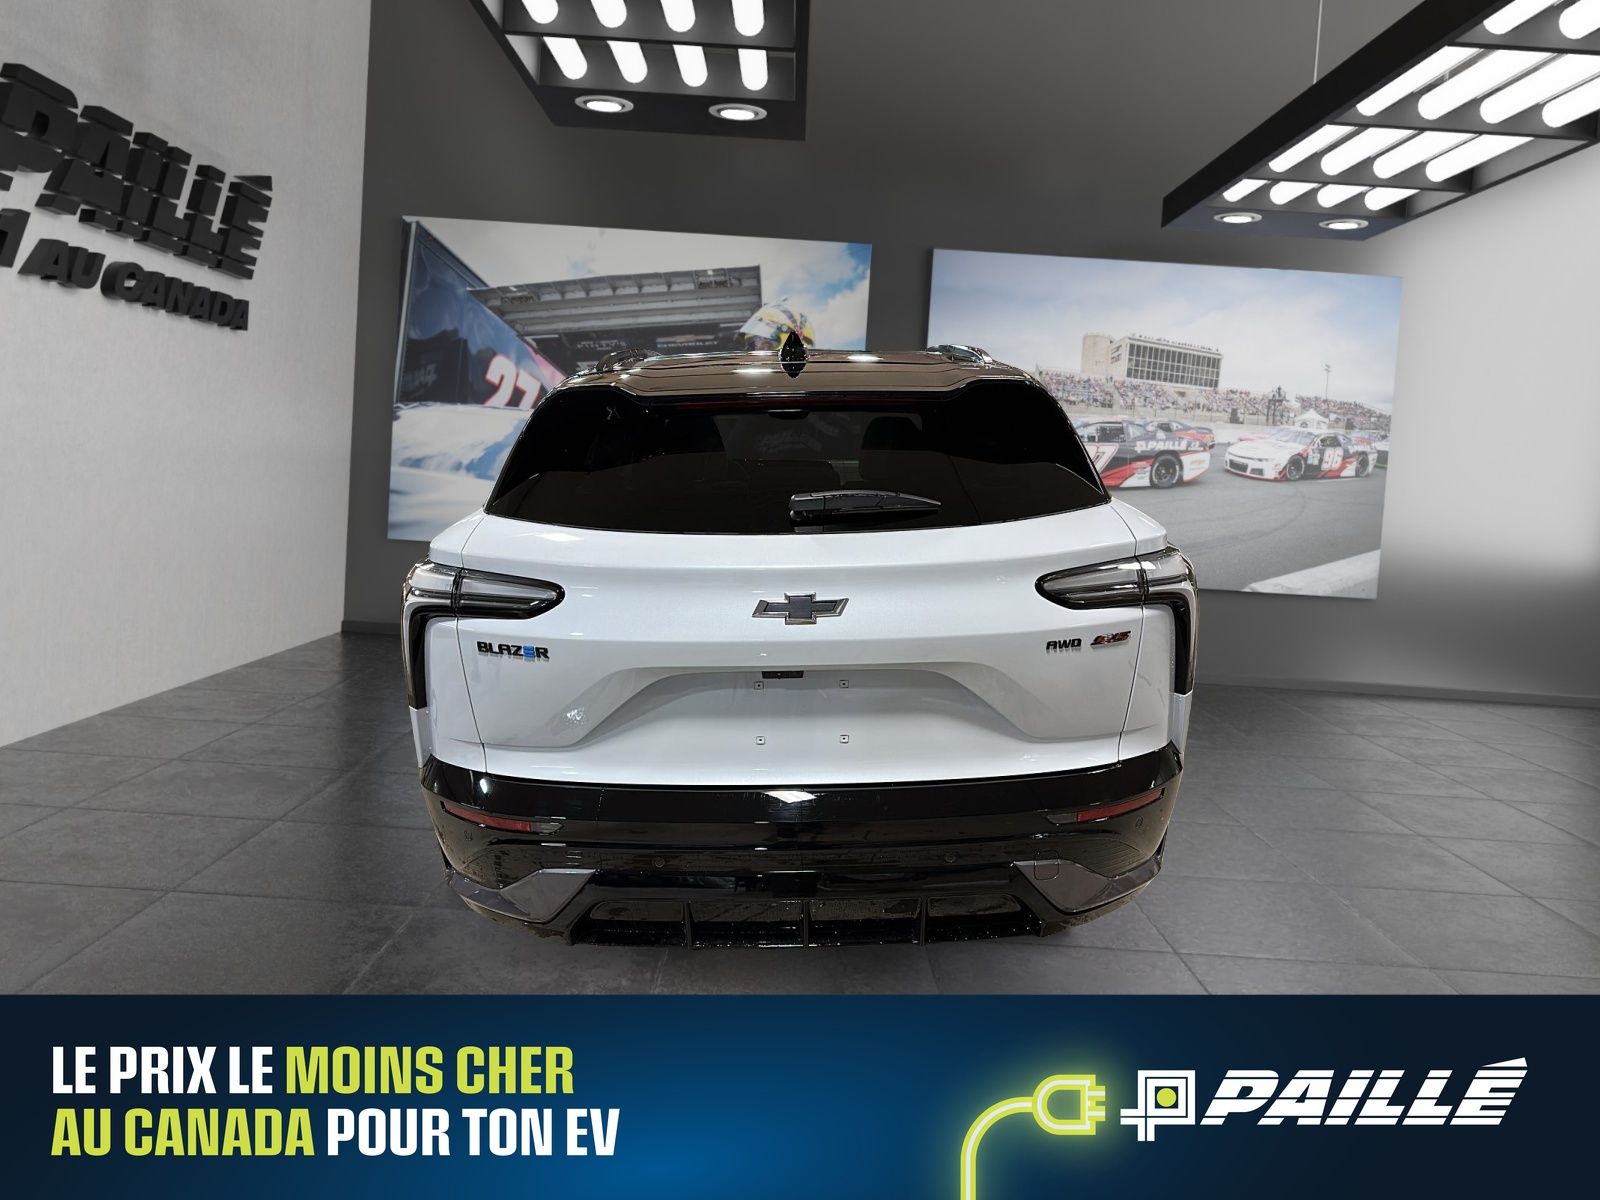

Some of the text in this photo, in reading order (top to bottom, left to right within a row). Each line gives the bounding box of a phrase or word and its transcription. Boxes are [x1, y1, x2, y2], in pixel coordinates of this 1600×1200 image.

[18, 238, 106, 289] AU
[100, 261, 249, 331] CANADA
[481, 353, 542, 411] 27
[476, 641, 550, 660] BLAZER
[1046, 638, 1082, 651] AWD
